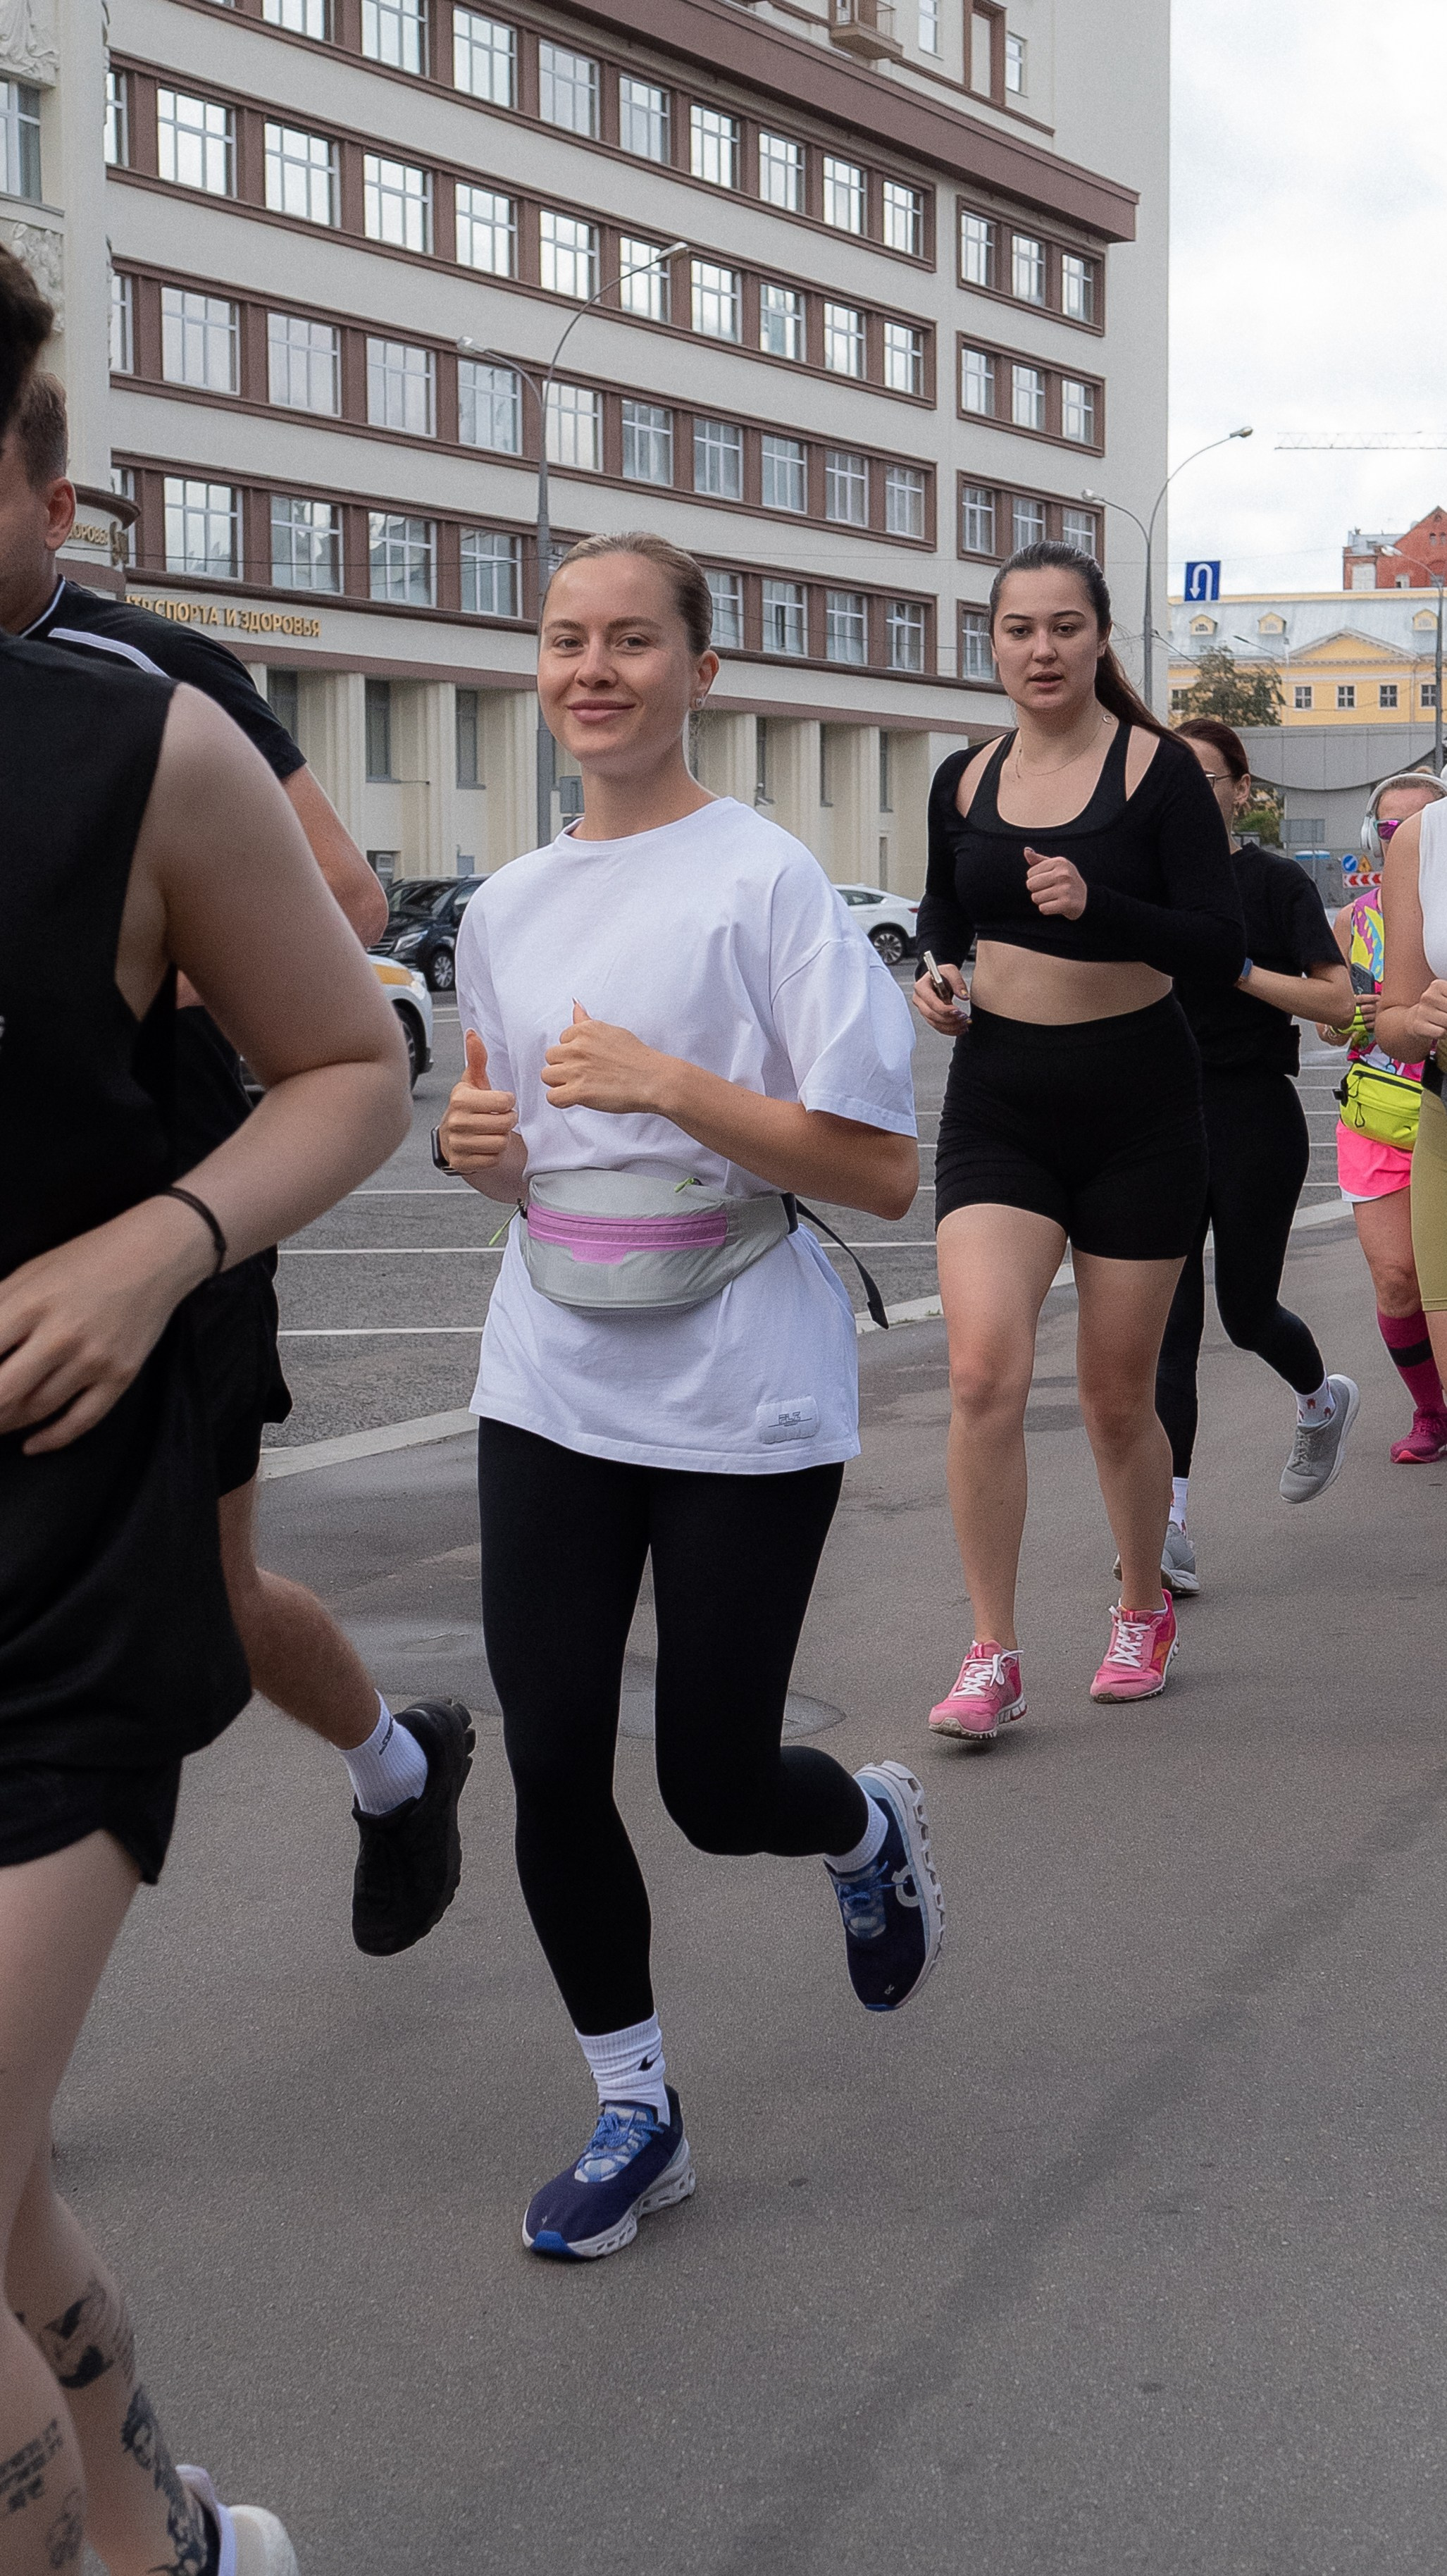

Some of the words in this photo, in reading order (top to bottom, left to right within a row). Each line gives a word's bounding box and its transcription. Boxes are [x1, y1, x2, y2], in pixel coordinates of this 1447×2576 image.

[154, 598, 221, 626] СПОРТА
[224, 608, 237, 628] И
[238, 609, 321, 638] ЗДОРОВЬЯ
